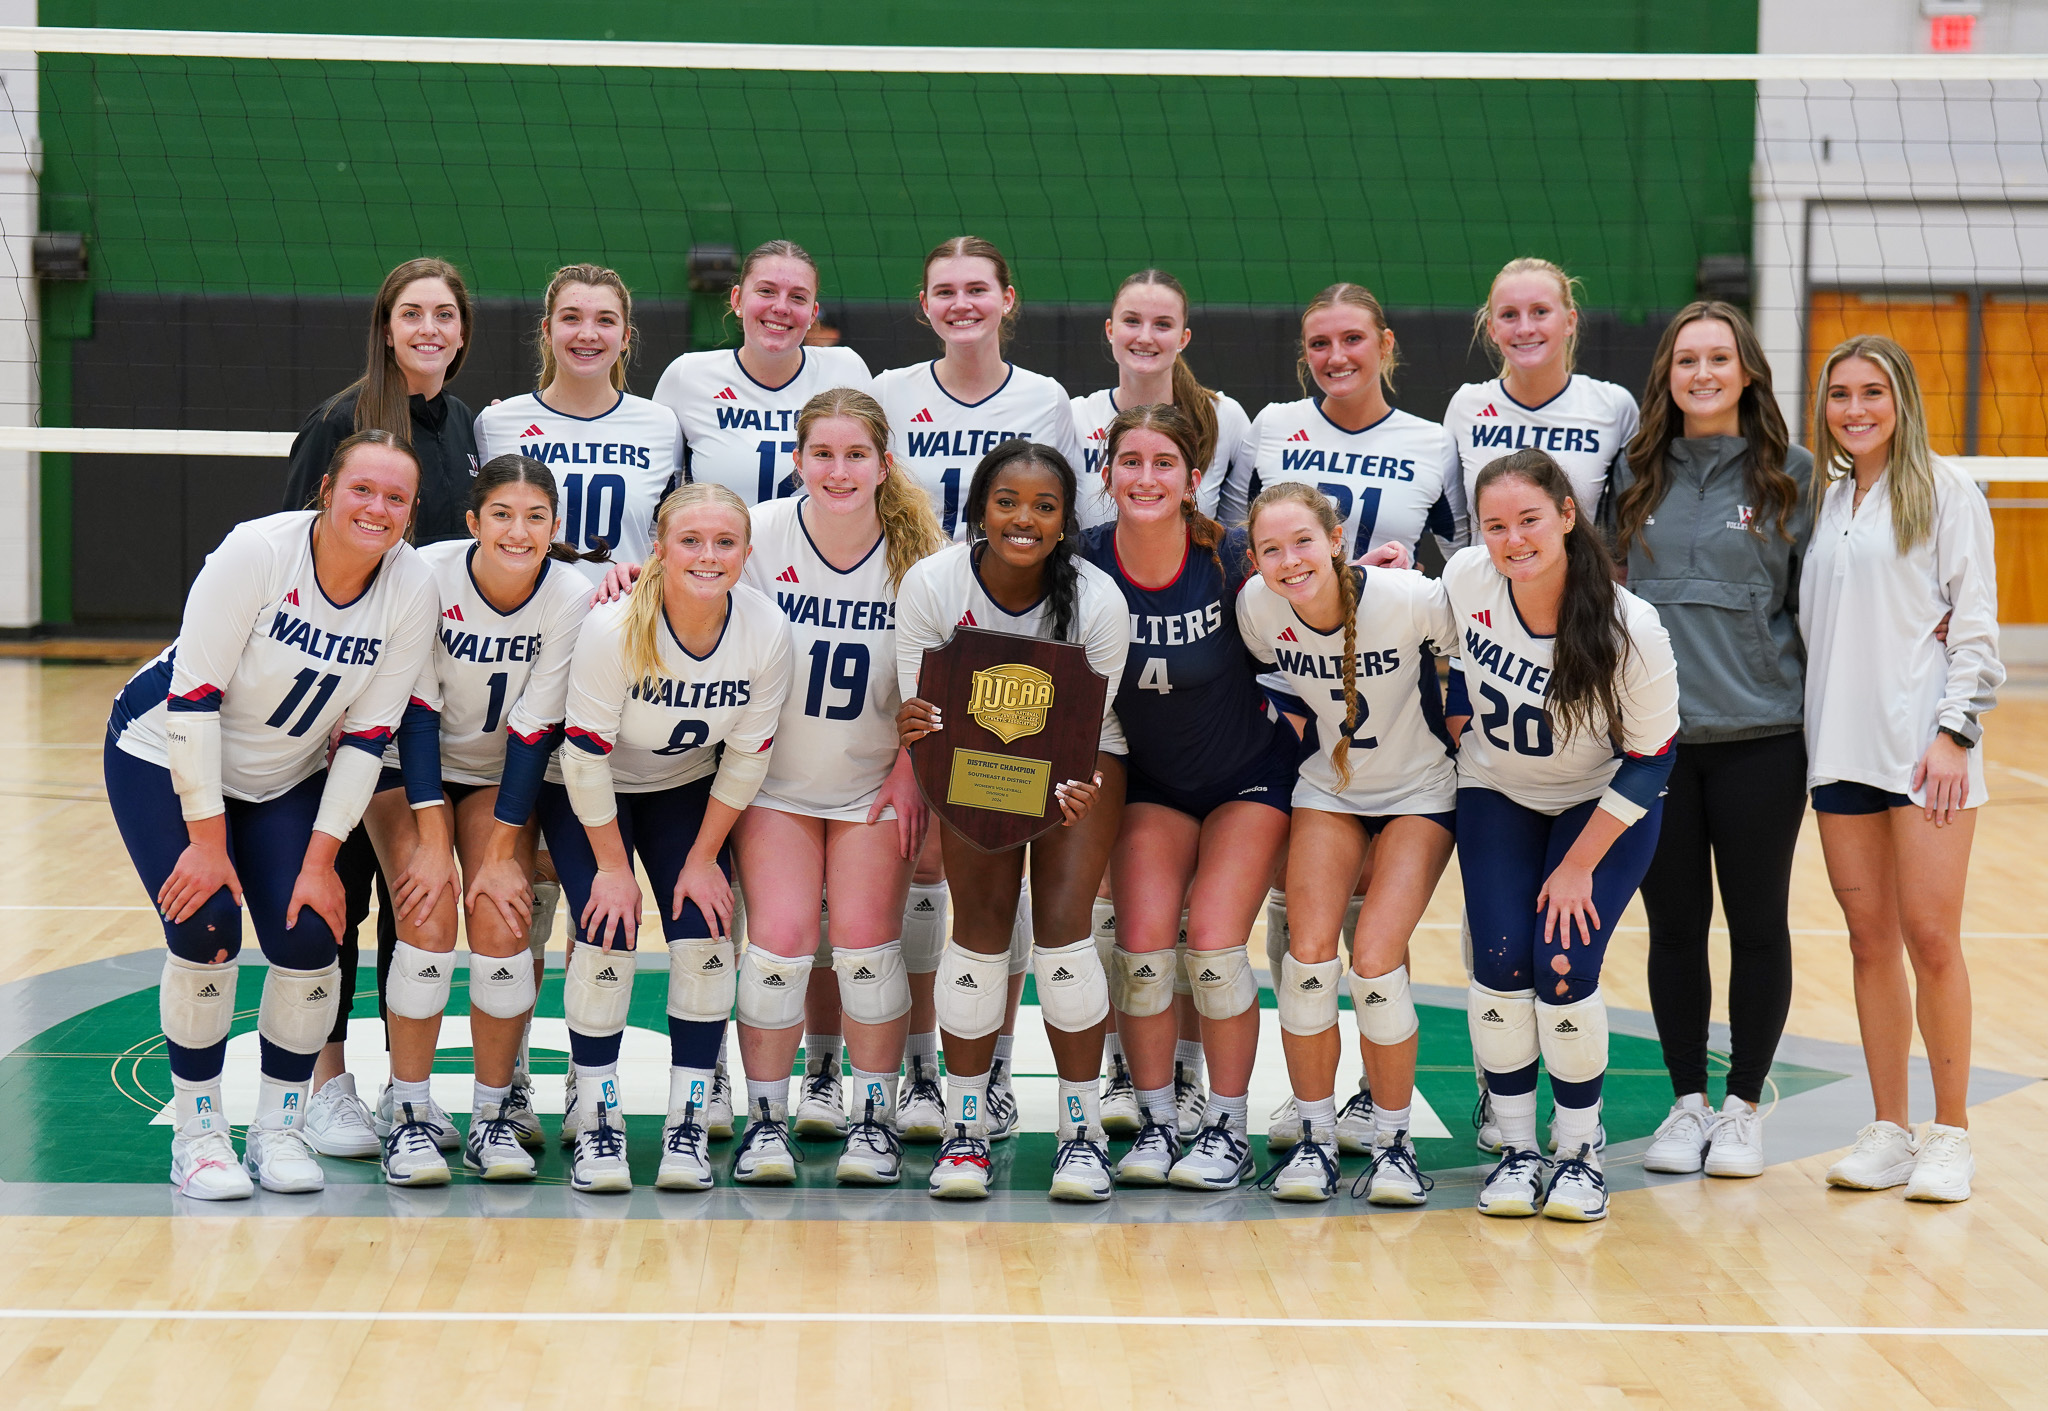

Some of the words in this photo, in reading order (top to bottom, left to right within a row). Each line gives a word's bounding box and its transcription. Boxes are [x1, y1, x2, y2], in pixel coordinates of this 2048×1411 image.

[717, 407, 802, 431] WALT
[1472, 424, 1600, 453] WALTERS
[520, 442, 651, 470] WALTERS
[1282, 449, 1415, 482] WALTERS
[562, 473, 626, 550] 10
[268, 611, 382, 666] WALTERS
[1129, 599, 1222, 646] LTERS
[1137, 657, 1173, 695] 4
[1275, 648, 1400, 679] WALTERS
[1465, 626, 1554, 697] WALTE
[631, 675, 751, 709] WALTERS
[804, 639, 870, 721] 19
[972, 675, 1051, 710] NJCAA
[264, 667, 342, 738] 11
[481, 672, 508, 733] 1
[1329, 688, 1379, 749] 2
[1479, 680, 1554, 757] 20
[967, 758, 999, 769] DISTRICT
[1000, 763, 1036, 775] CHAMPION
[967, 771, 1001, 780] SOUTHEAST
[1006, 777, 1032, 785] DISTRICT
[702, 962, 724, 970] adidas
[1051, 973, 1075, 982] adidas
[306, 993, 328, 1001] adidas
[955, 980, 978, 989] adidas
[1481, 1015, 1504, 1023] adidas
